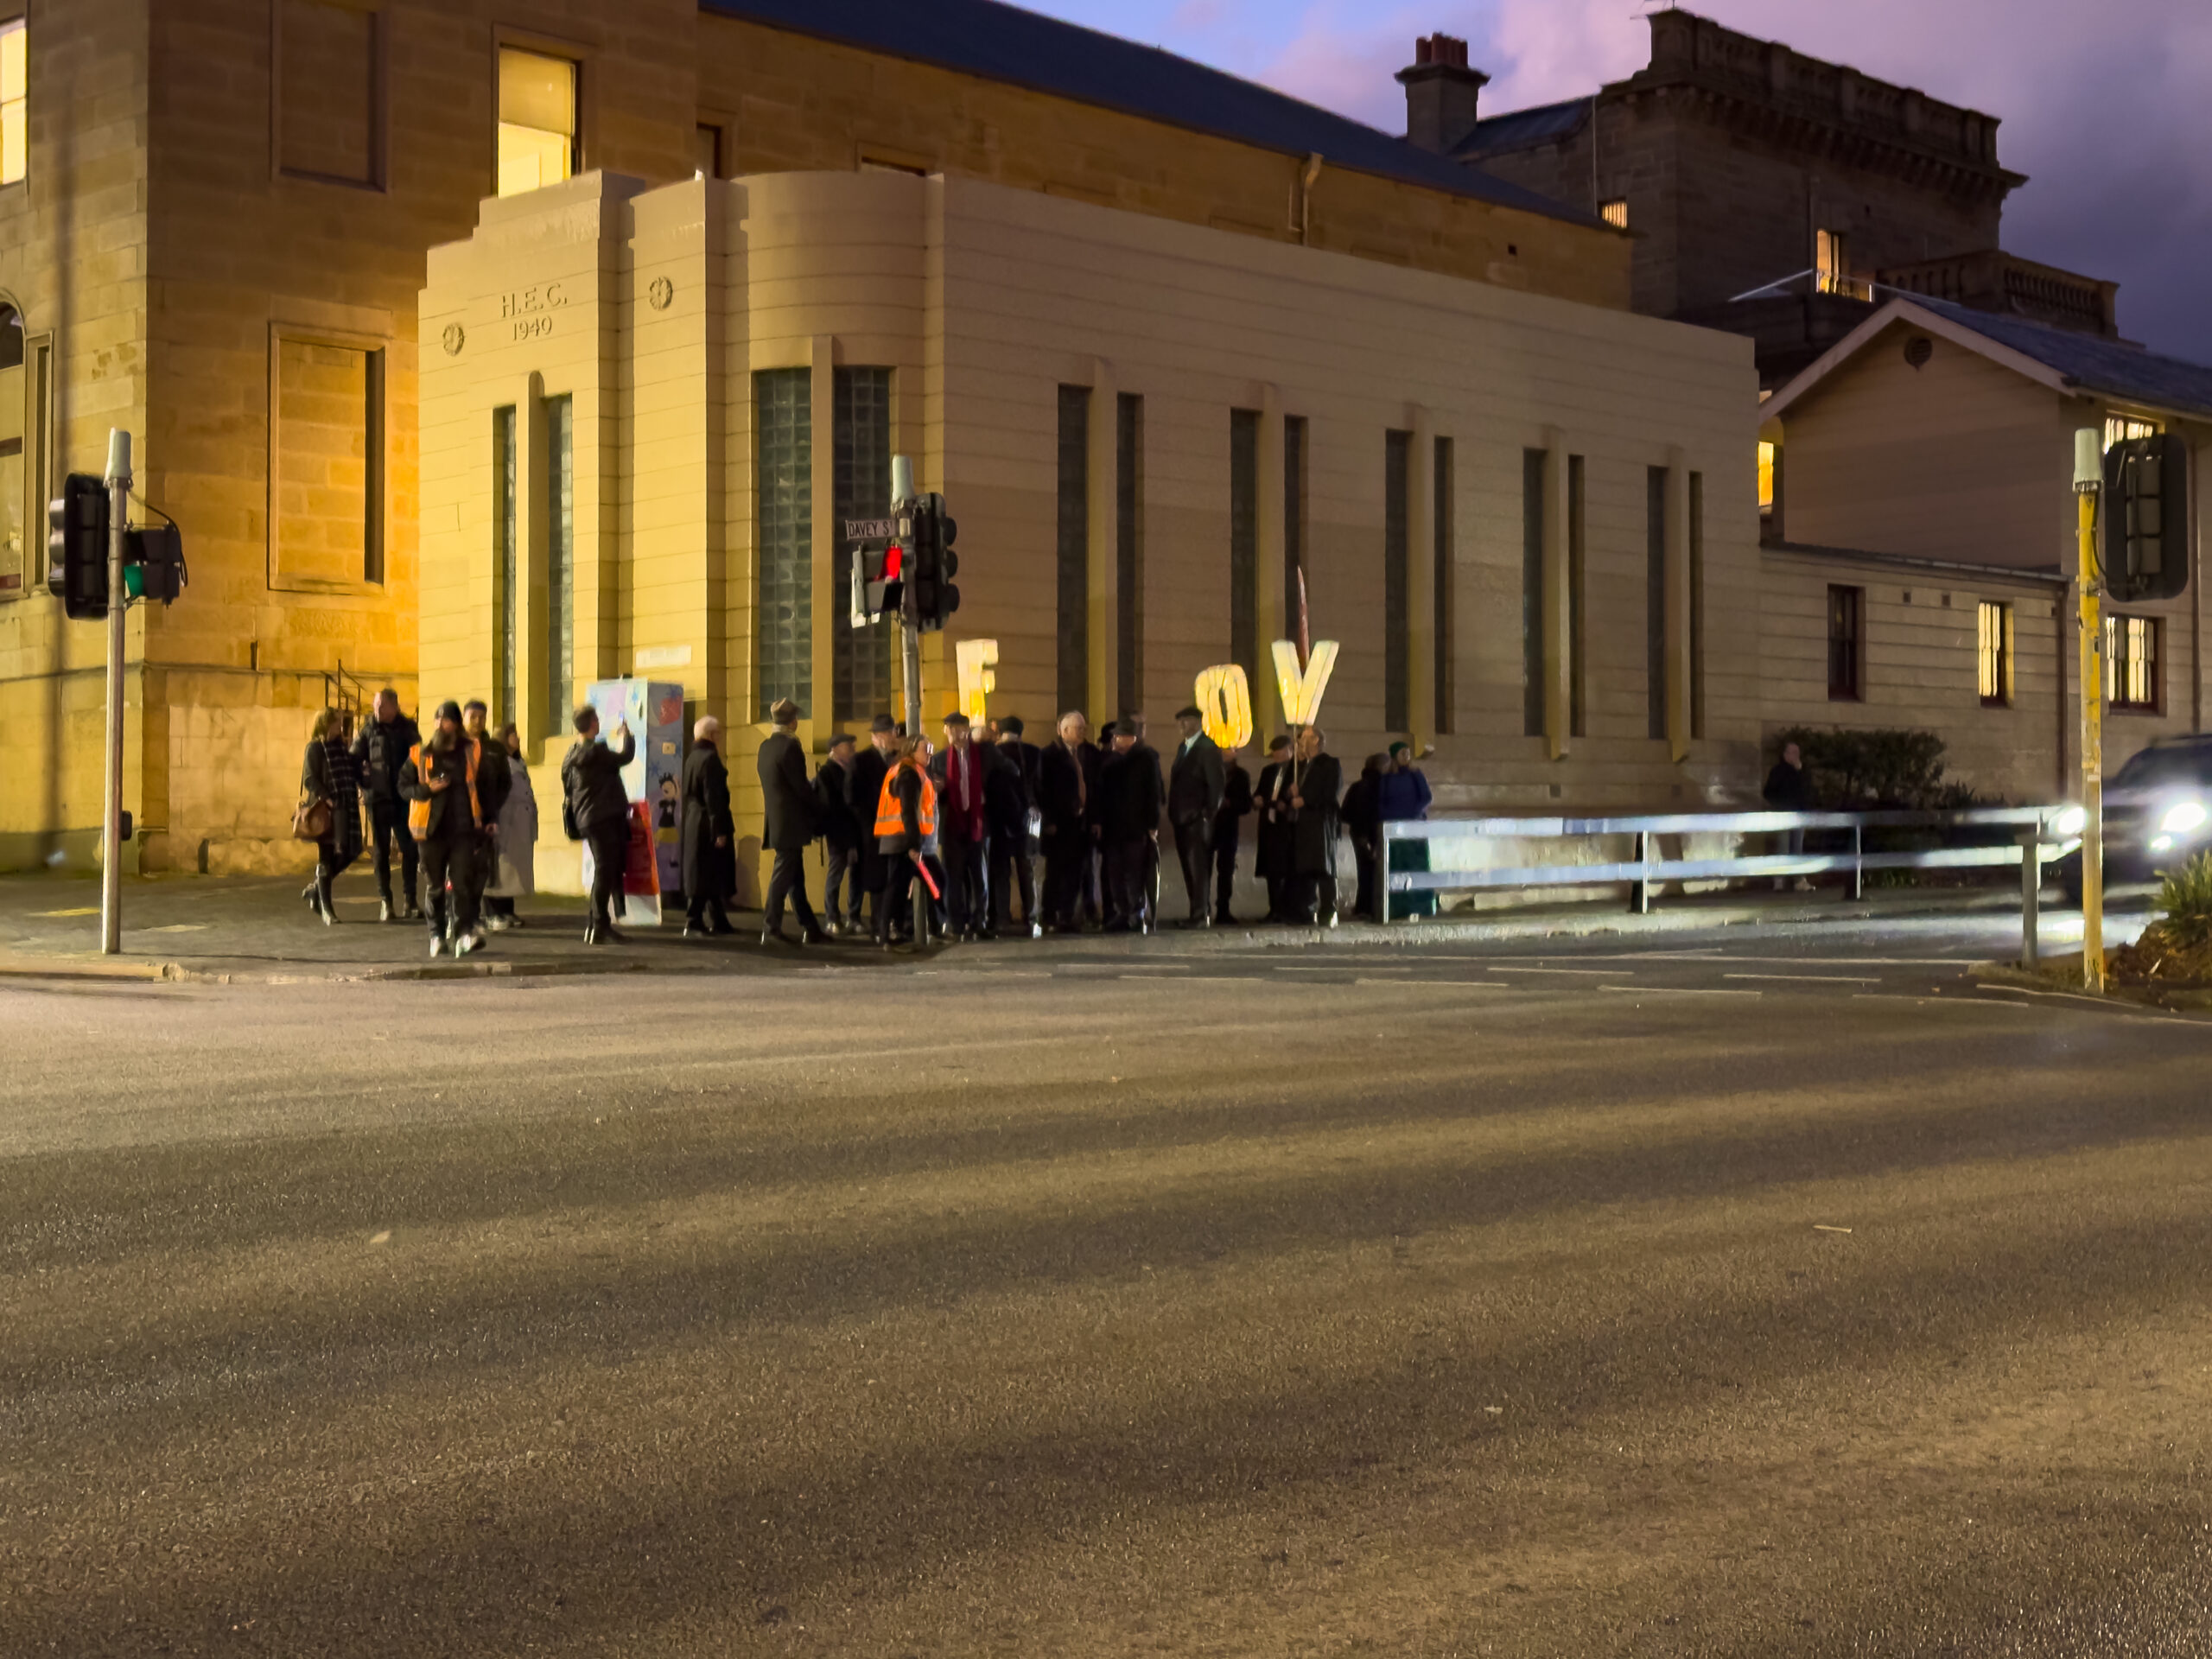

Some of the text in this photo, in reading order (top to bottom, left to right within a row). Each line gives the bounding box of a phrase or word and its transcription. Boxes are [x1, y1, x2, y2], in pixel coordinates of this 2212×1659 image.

[501, 282, 568, 318] H.E.C.
[512, 316, 553, 341] 1940
[849, 522, 878, 537] DAVEY
[956, 639, 999, 727] F
[1271, 639, 1339, 725] V
